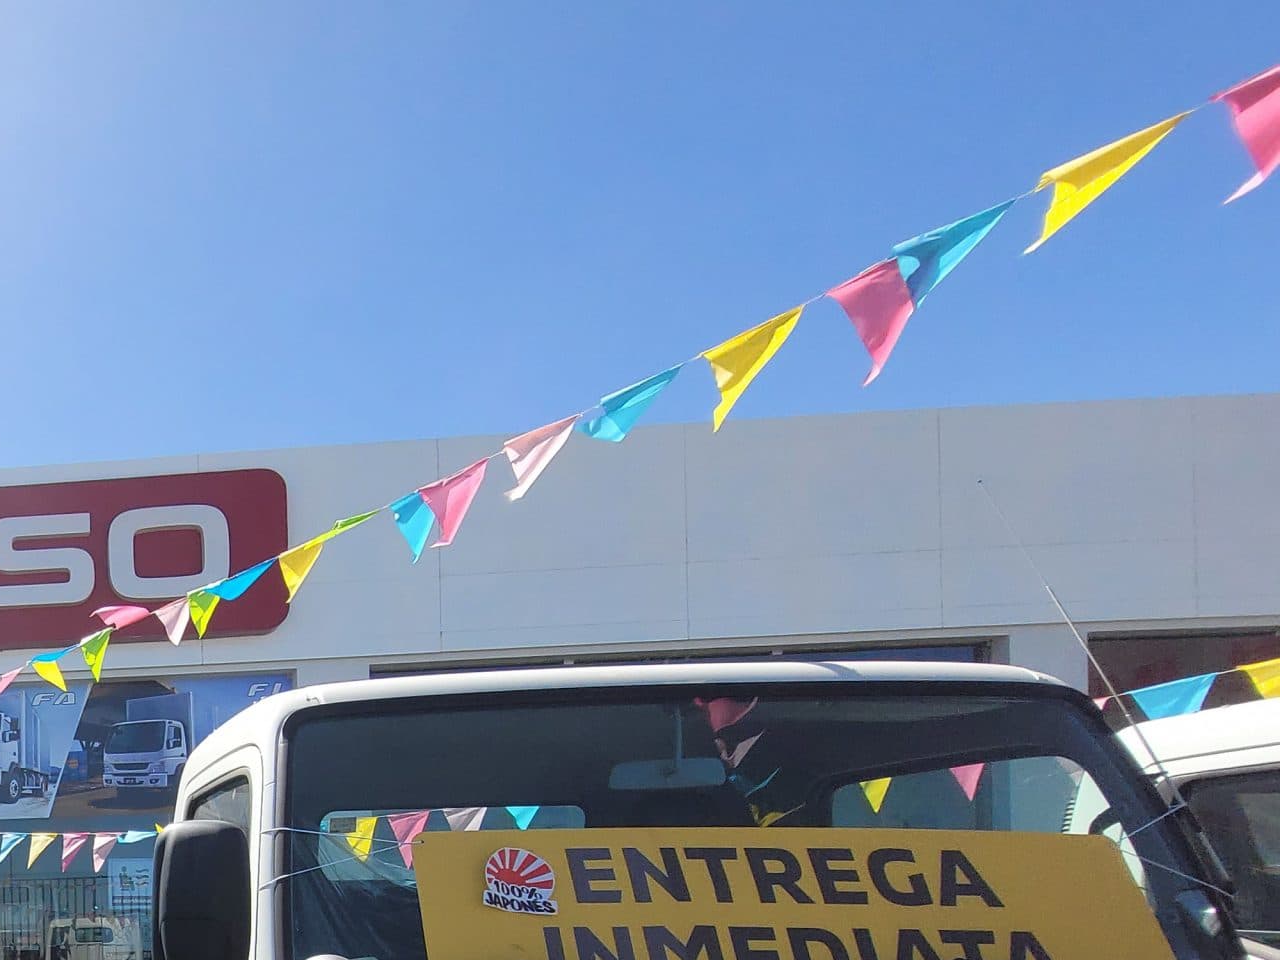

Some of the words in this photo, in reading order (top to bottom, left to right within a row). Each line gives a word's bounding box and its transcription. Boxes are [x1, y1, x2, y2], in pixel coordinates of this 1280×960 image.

[32, 692, 75, 706] FA
[564, 847, 1006, 908] ENTREGA
[493, 880, 543, 900] 100%
